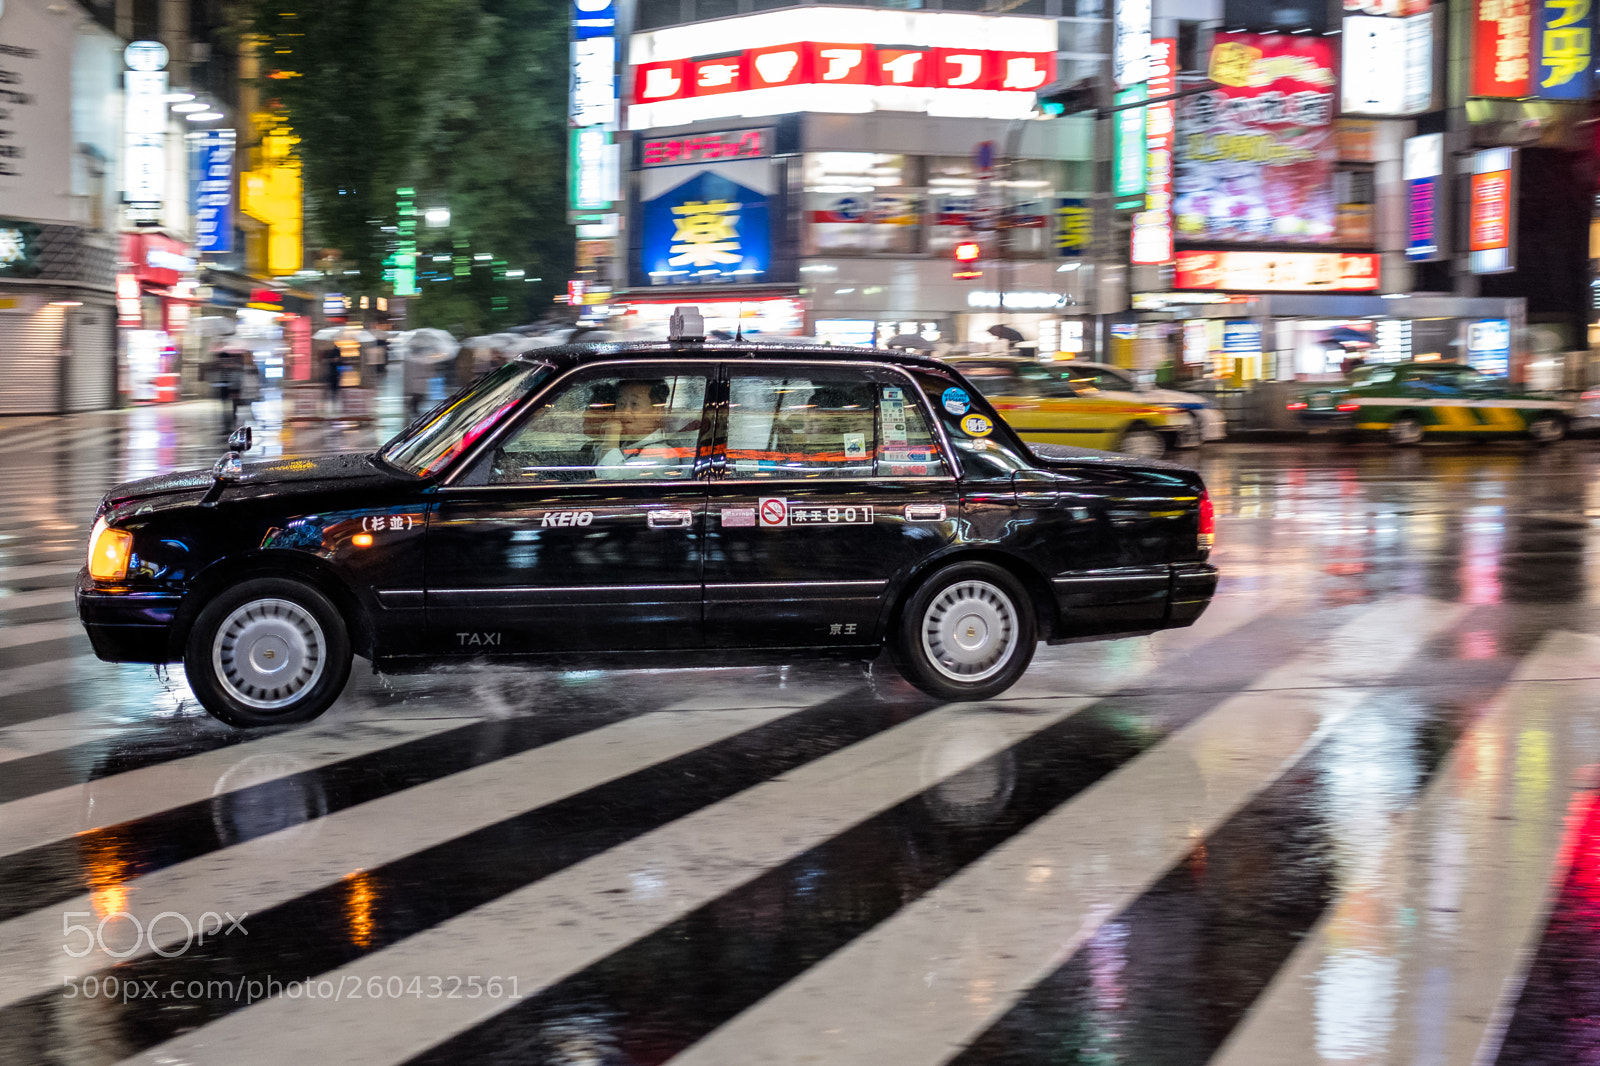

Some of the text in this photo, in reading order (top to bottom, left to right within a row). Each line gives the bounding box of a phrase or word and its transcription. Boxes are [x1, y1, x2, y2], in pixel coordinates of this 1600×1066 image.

[820, 48, 1047, 89] アイフル
[667, 199, 744, 267] 薬
[541, 511, 594, 527] KEIO
[795, 507, 869, 523] 京王 801
[829, 623, 857, 635] 京王
[456, 632, 501, 646] TAXI
